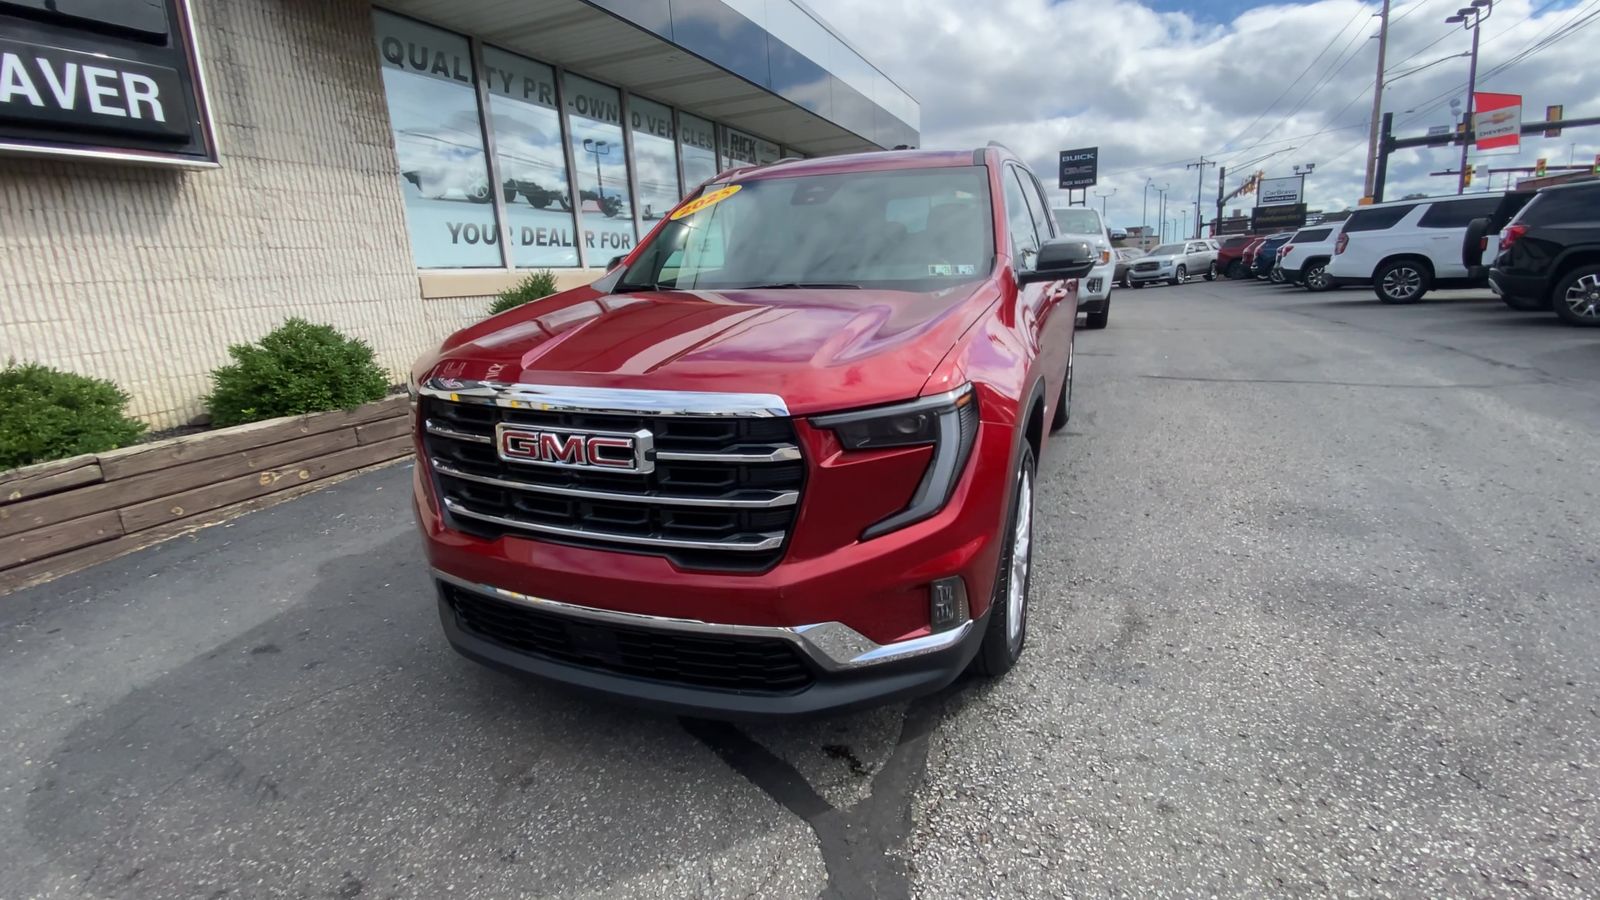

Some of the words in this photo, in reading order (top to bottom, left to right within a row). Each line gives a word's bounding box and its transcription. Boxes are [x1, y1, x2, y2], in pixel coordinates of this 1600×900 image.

[382, 36, 514, 94] QUALTY
[523, 76, 641, 128] PR-OWND
[1062, 153, 1095, 162] BUICK
[601, 231, 631, 250] FOR
[501, 429, 635, 469] GMC
